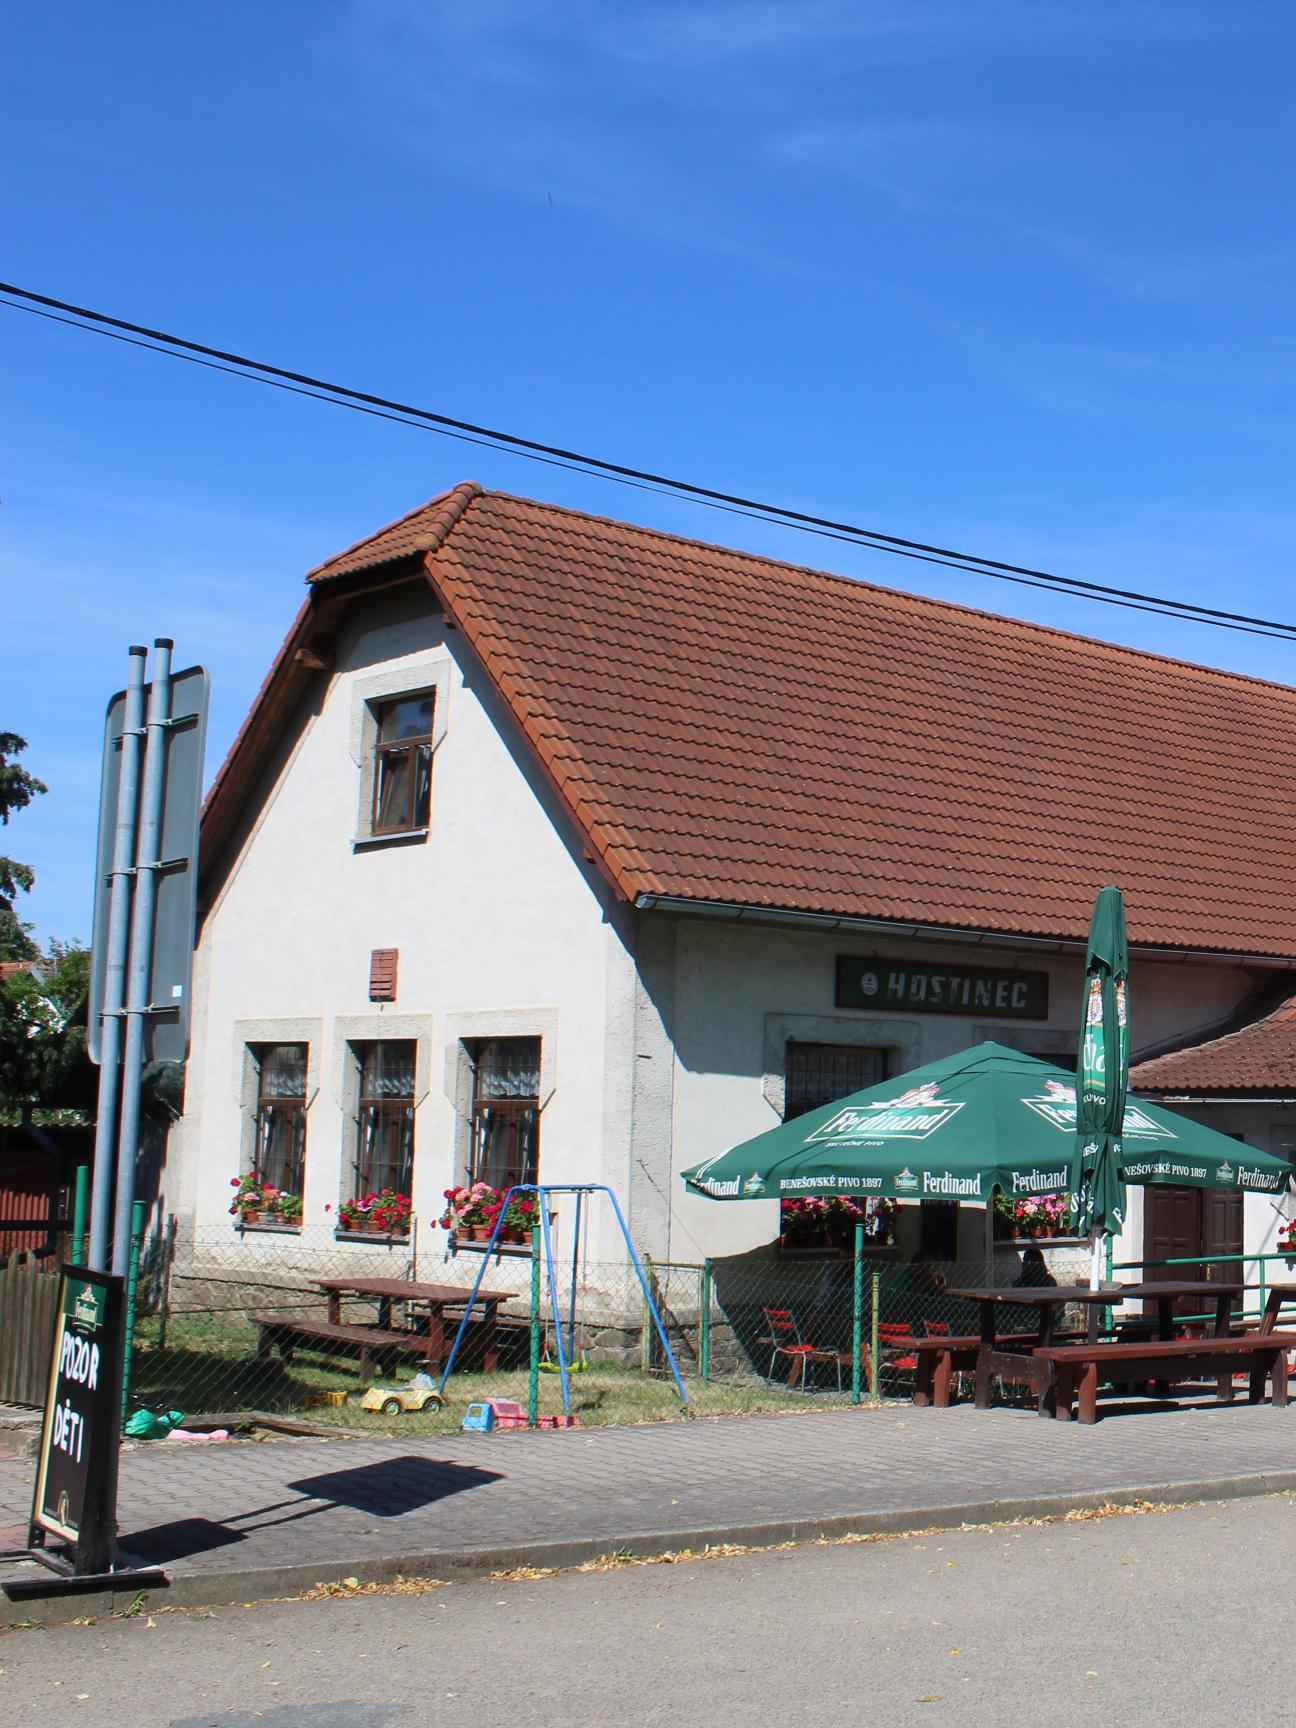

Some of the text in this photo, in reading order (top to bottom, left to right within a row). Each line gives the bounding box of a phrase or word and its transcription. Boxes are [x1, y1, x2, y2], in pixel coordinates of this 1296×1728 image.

[888, 972, 1028, 1008] HOSTINEC
[823, 1109, 950, 1133] Ferdinand
[780, 1174, 882, 1190] BENEŠOVSKÉ PIVO 1897
[923, 1171, 981, 1196] Ferdinand
[1012, 1165, 1068, 1193] Ferdinand
[1172, 1166, 1189, 1176] PIVO
[1190, 1167, 1207, 1178] 1897
[59, 1331, 100, 1391] POZOR
[53, 1398, 85, 1464] DĚTI
